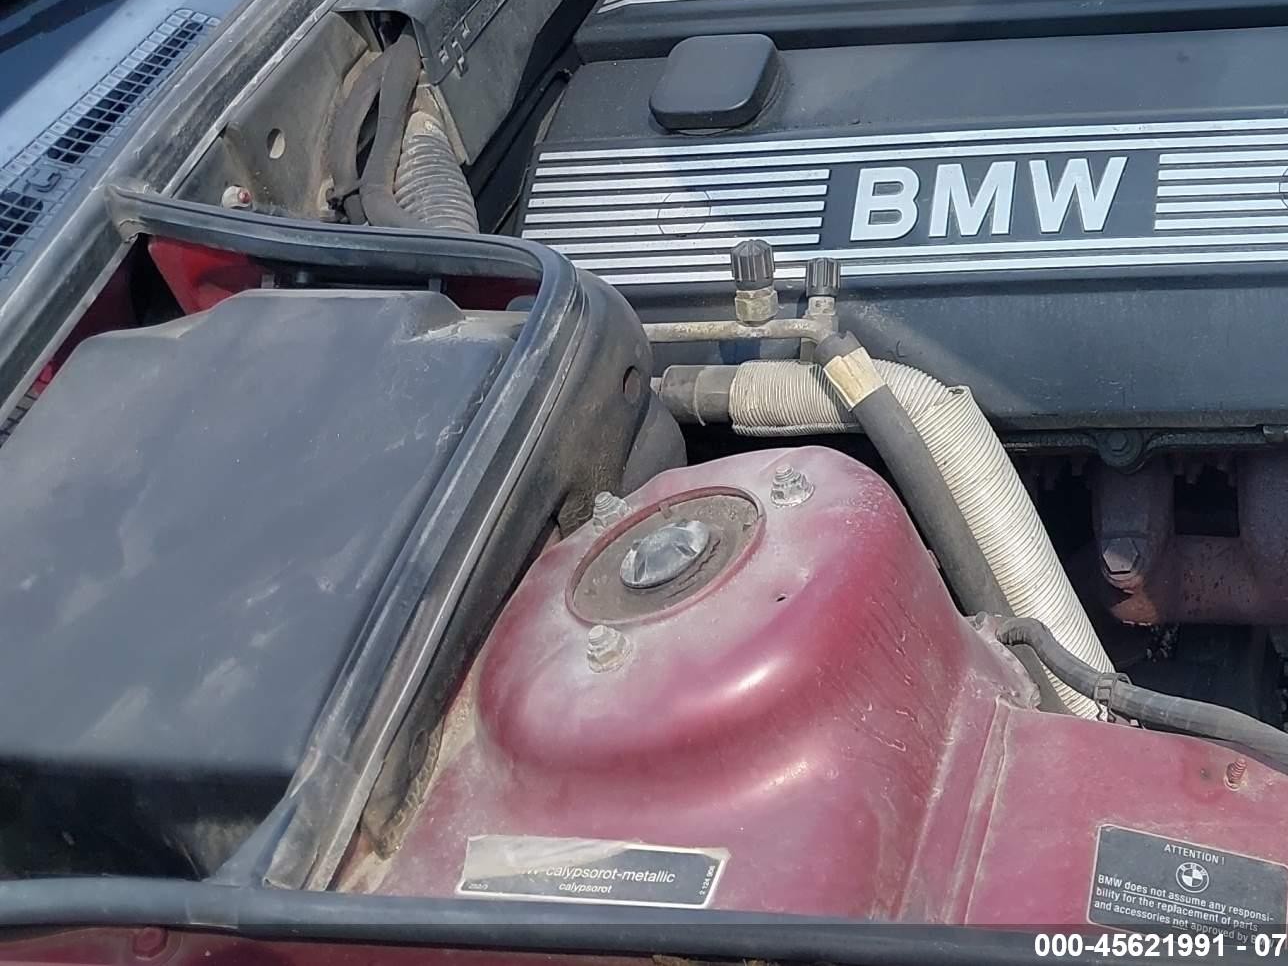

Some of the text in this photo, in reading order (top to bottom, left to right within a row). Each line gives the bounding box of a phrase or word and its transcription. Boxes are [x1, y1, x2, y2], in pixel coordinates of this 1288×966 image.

[850, 156, 1129, 242] BMW
[1164, 843, 1219, 864] ATTENTION
[558, 882, 613, 894] calypsorot
[1096, 887, 1258, 932] bility for the replacement of parts
[1098, 874, 1274, 922] BMW does not assume any responsi-
[1094, 900, 1112, 911] and
[1113, 904, 1170, 924] accessories
[1172, 918, 1188, 928] not
[1191, 921, 1235, 939] approved
[1237, 932, 1248, 943] by
